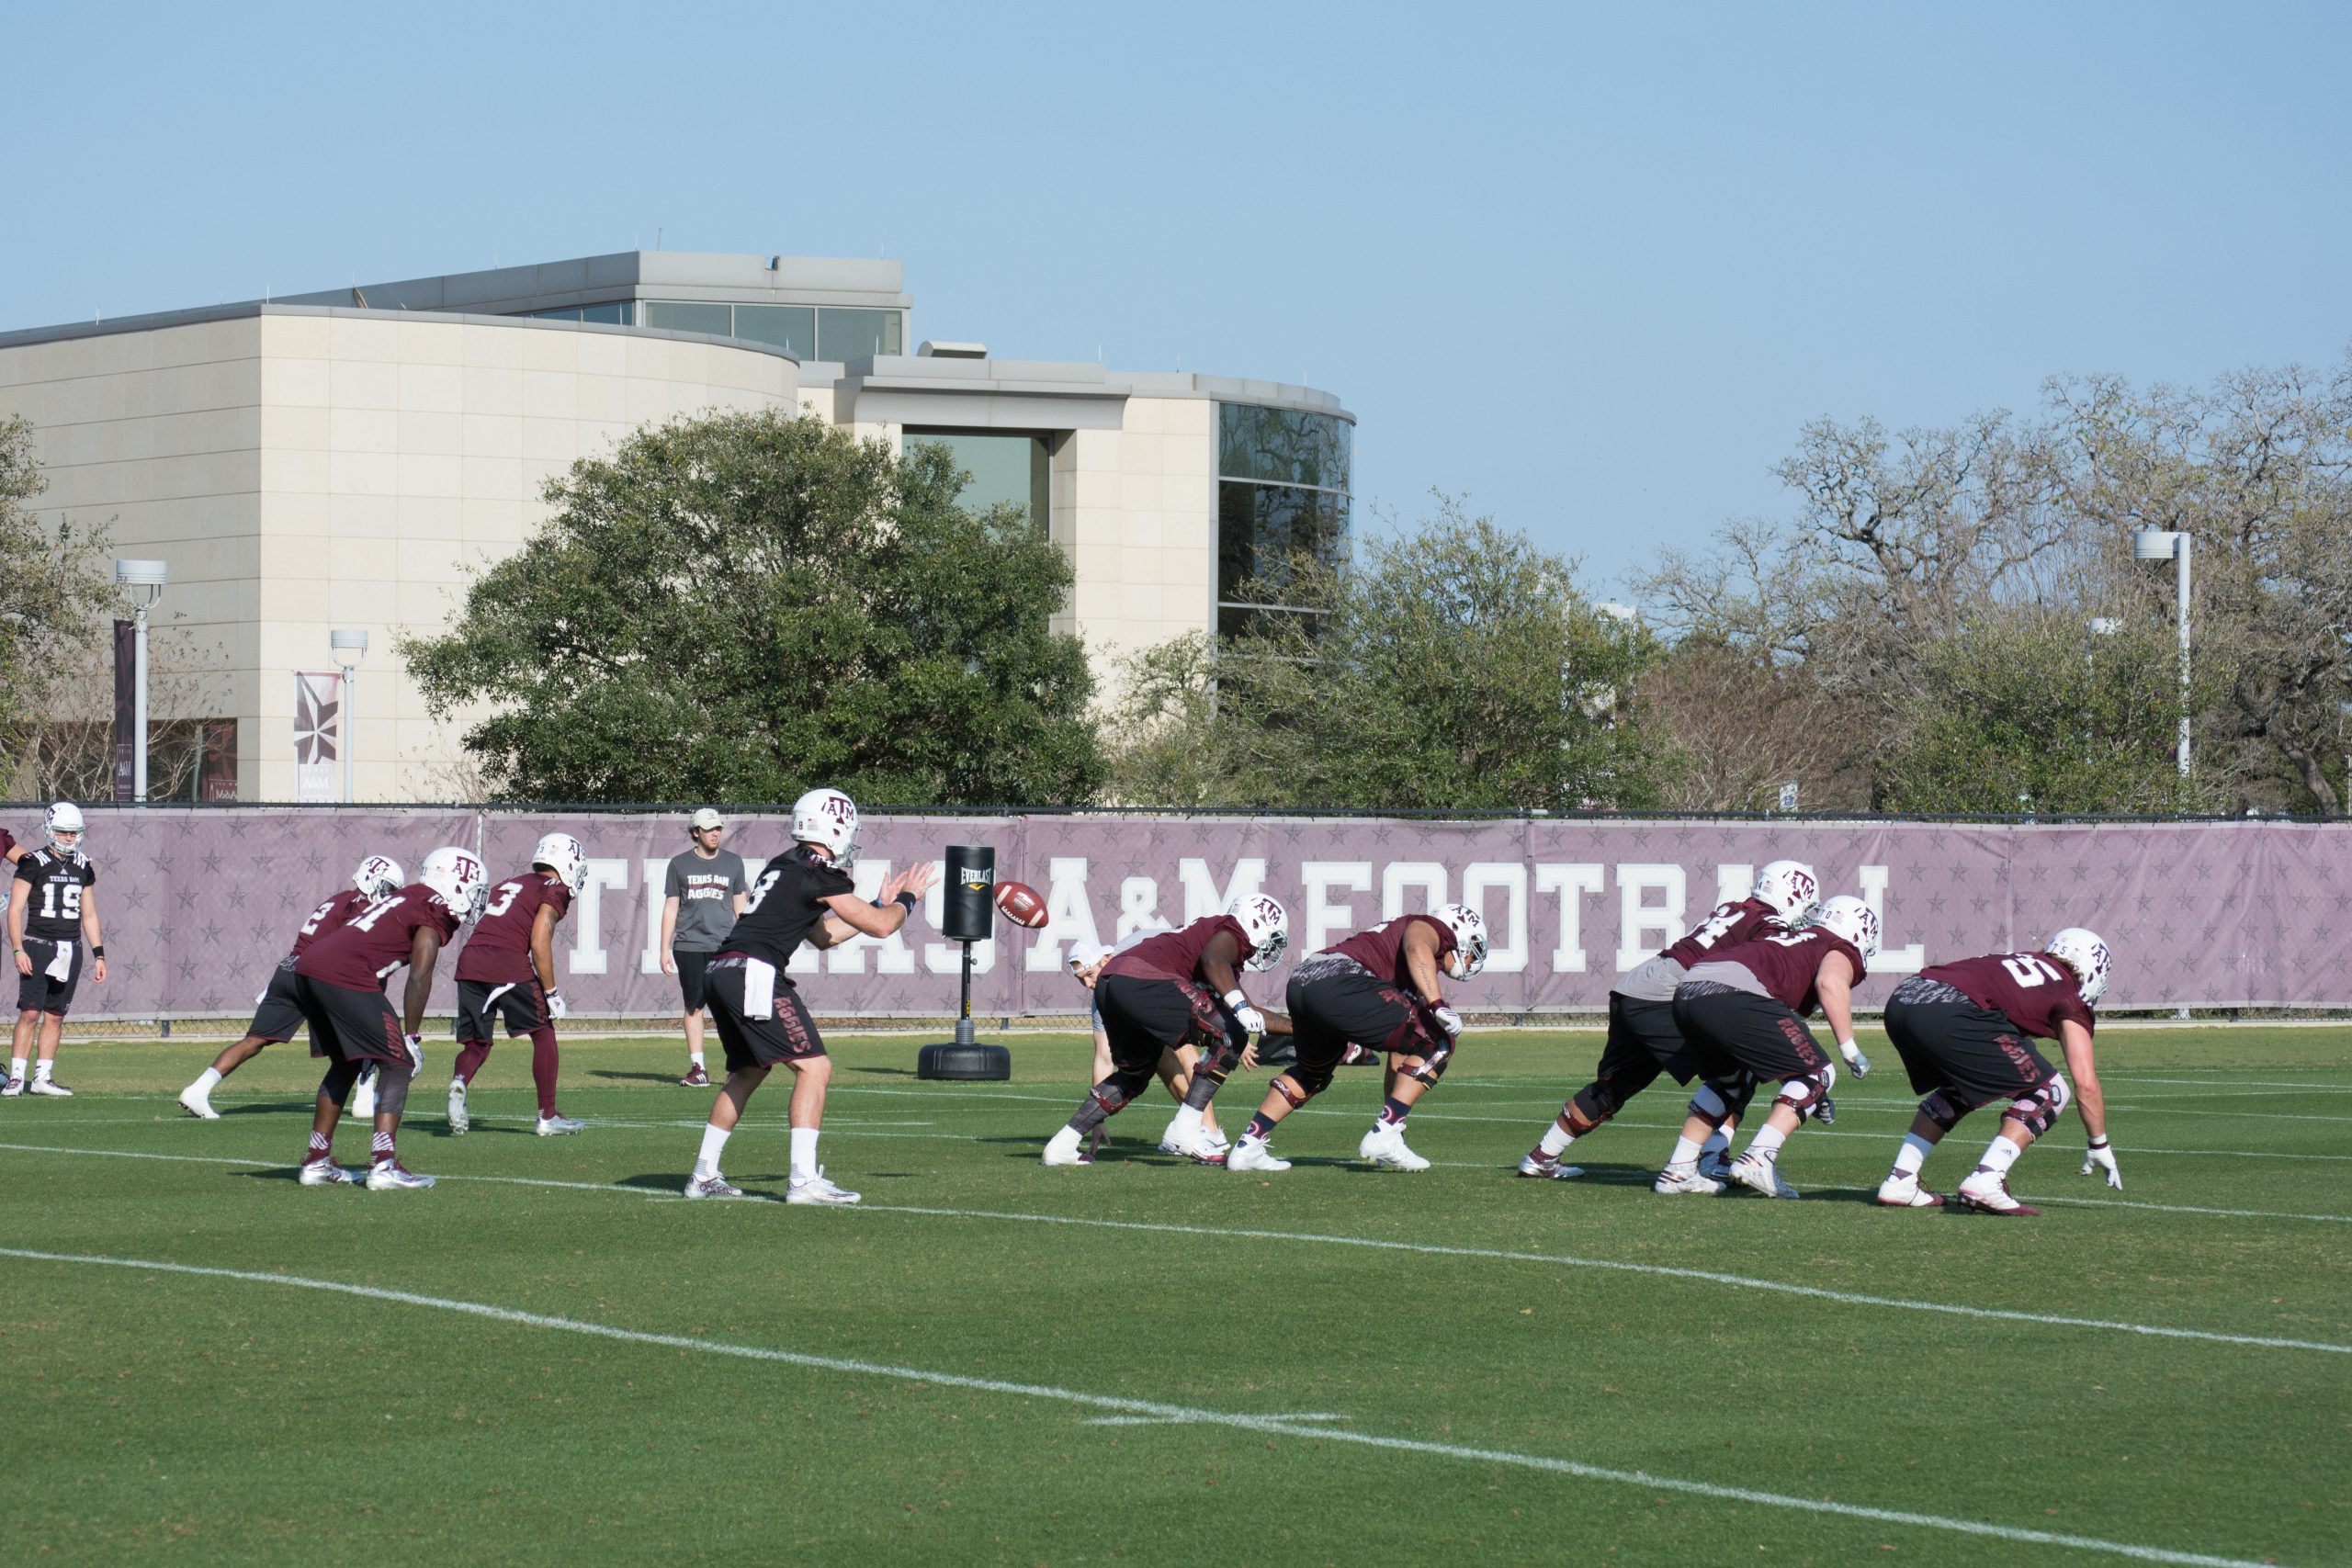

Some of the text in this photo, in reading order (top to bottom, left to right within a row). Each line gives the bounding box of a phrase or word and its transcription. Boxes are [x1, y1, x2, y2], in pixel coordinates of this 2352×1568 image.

[687, 874, 729, 886] TEXAS A&M
[960, 867, 991, 885] EVERLAST
[40, 883, 83, 919] 19
[485, 882, 523, 917] 3
[687, 887, 725, 900] AGGIES
[774, 997, 811, 1054] AGGIES
